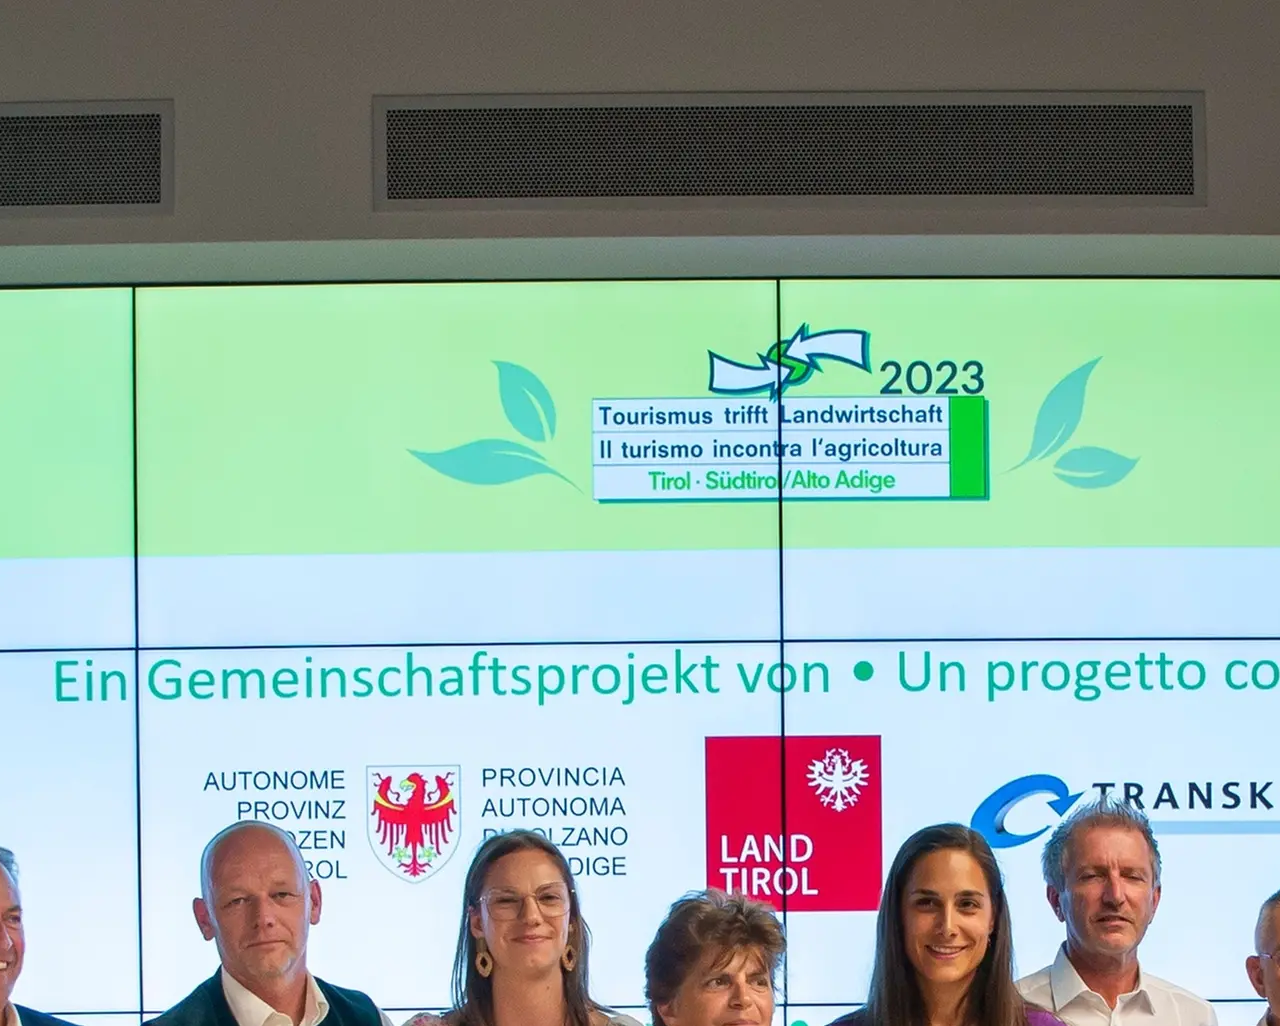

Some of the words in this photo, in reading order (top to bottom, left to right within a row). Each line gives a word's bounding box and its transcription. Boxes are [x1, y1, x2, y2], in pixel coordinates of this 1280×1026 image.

[879, 360, 985, 395] 2023
[599, 405, 713, 426] Tourismus
[724, 405, 769, 425] trifft
[780, 404, 943, 424] Landwirtschaft
[600, 440, 612, 459] Il
[621, 440, 704, 459] turismo
[713, 439, 802, 458] incontra
[812, 438, 943, 462] l'agricoltura
[648, 470, 691, 491] Tirol
[834, 469, 896, 494] Adige
[55, 659, 127, 702] Ein
[147, 649, 720, 706] Gemeinschaftsprojekt
[735, 660, 830, 693] von
[898, 651, 966, 692] Un
[988, 652, 1206, 702] progetto
[203, 770, 346, 791] AUTONOME
[482, 767, 626, 787] PROVINCIA
[237, 800, 346, 820] PROVINZ
[481, 797, 627, 818] AUTONOMA
[286, 830, 346, 849] ZEN
[721, 833, 814, 863] LAND
[568, 856, 627, 876] DIGE
[719, 866, 819, 896] TIROL
